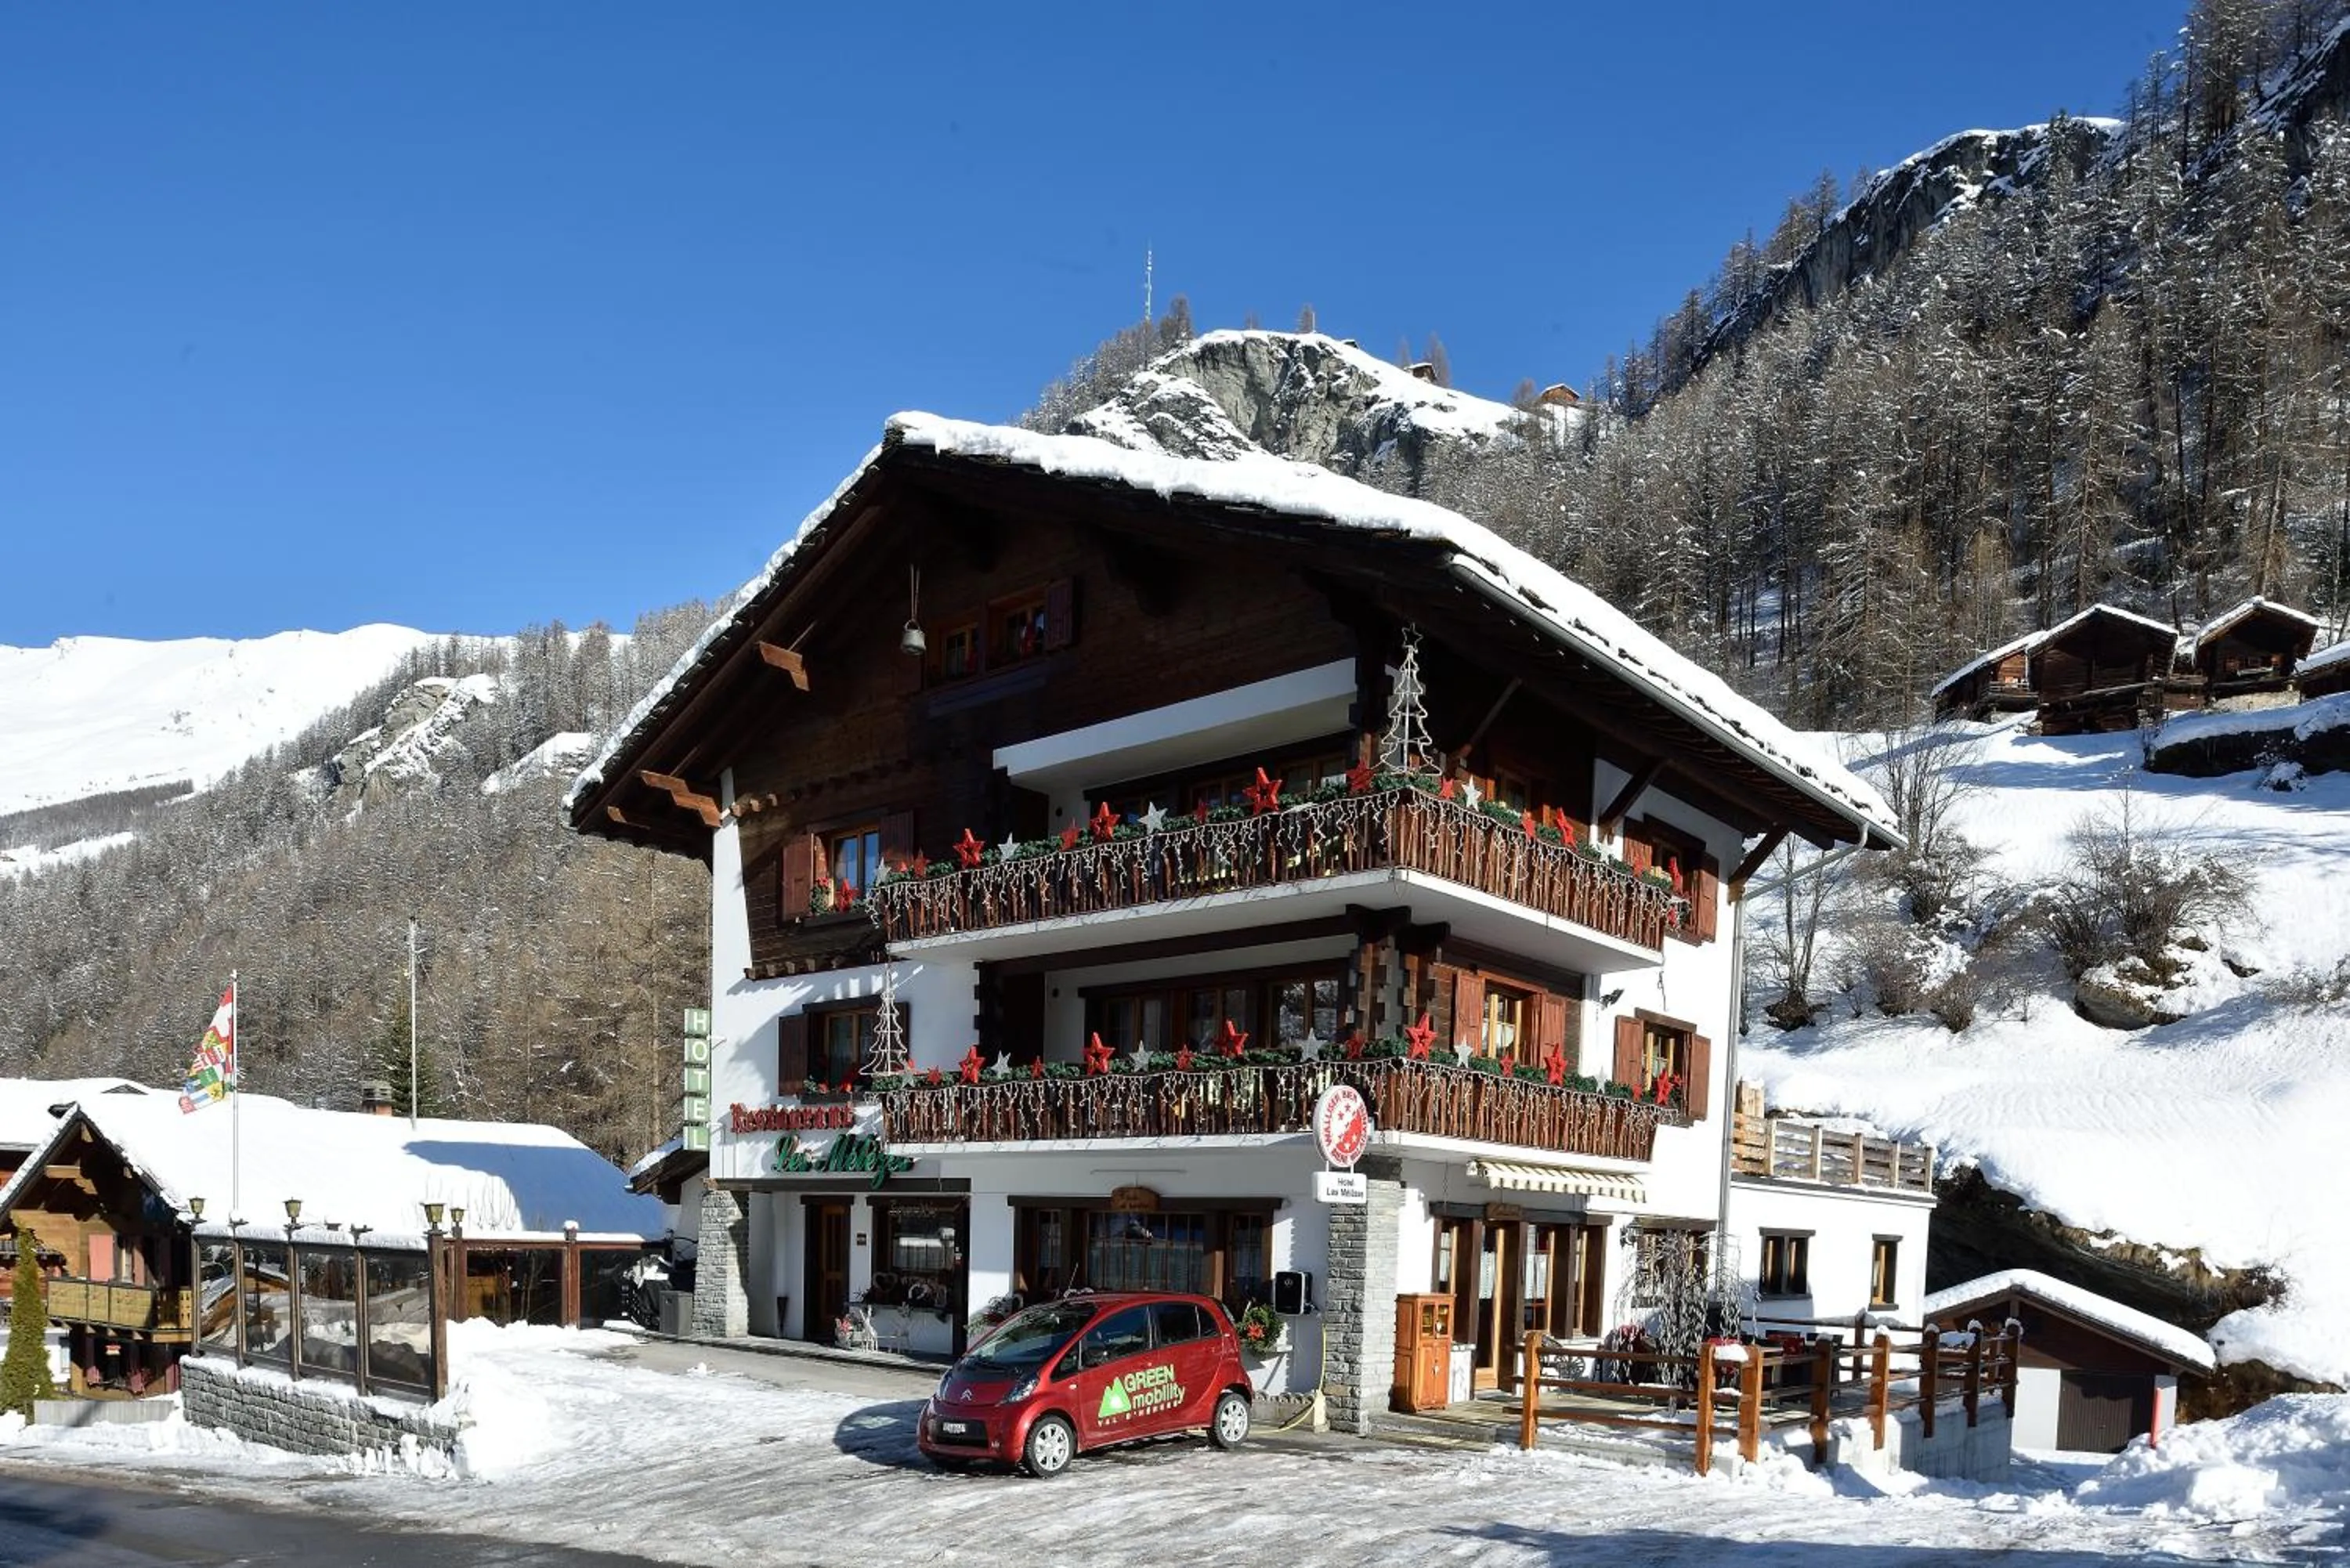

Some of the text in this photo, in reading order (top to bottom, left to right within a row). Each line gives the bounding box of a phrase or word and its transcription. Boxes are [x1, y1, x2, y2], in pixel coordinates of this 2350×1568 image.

[692, 1011, 707, 1149] HOTEL
[730, 1102, 855, 1133] Restaurant
[1124, 1364, 1174, 1393] GREEN
[1133, 1382, 1185, 1409] mobility
[1097, 1417, 1117, 1428] VAL
